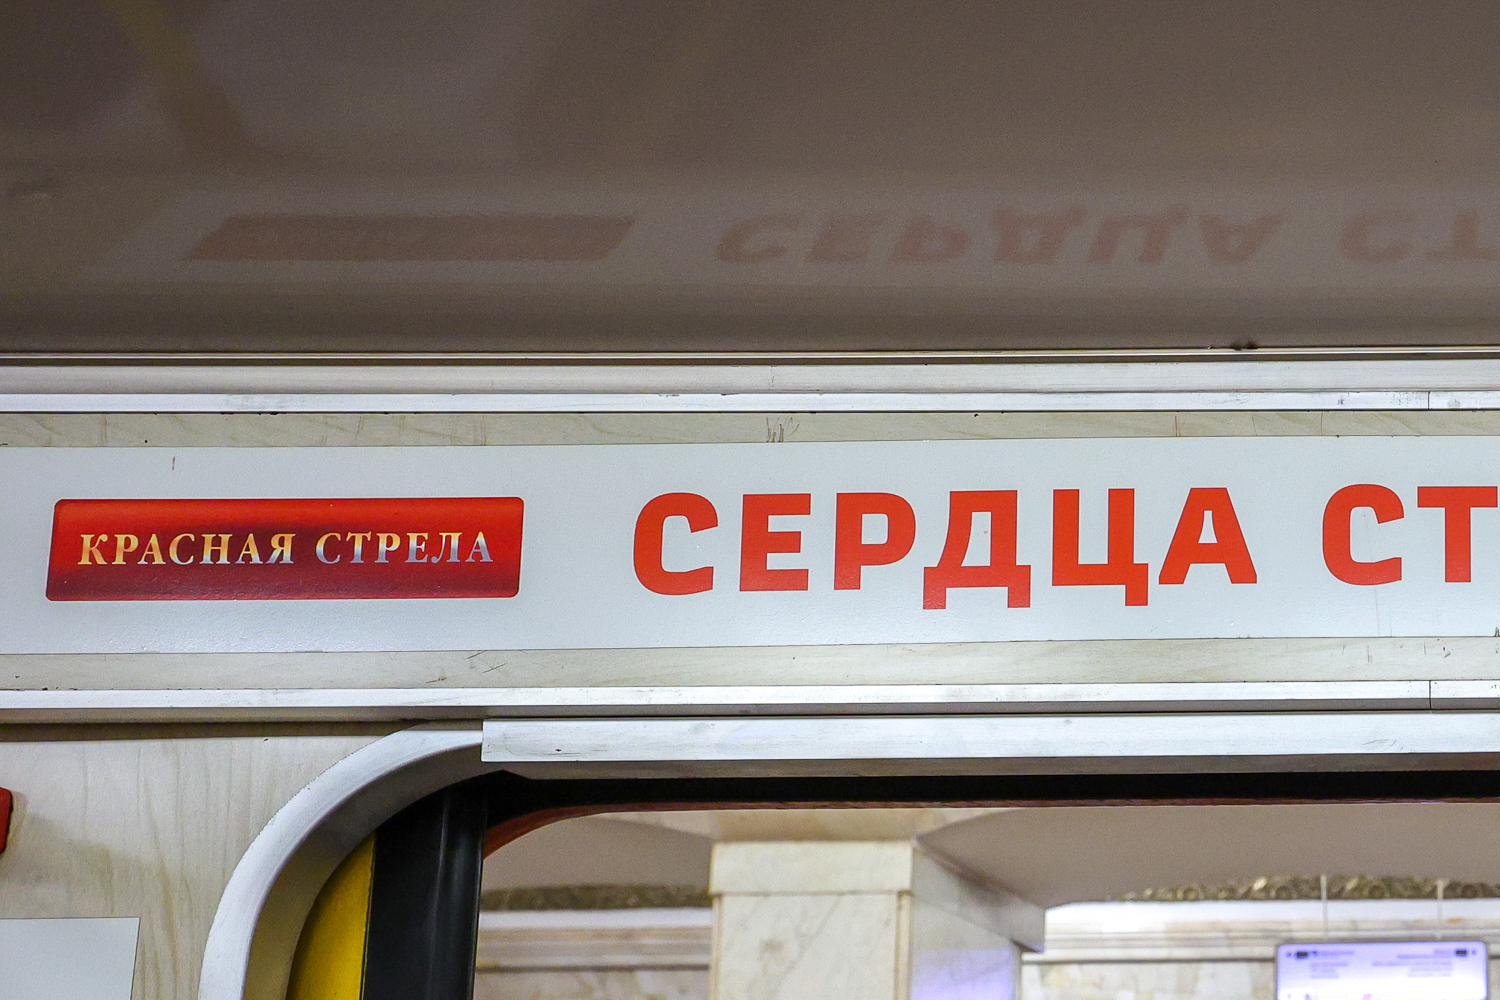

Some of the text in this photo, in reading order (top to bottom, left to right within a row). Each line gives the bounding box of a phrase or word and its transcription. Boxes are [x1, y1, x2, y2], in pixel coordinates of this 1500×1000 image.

[78, 530, 494, 567] КРАСНАЯ СТРЕЛА
[633, 488, 1257, 609] СЕРДЦА
